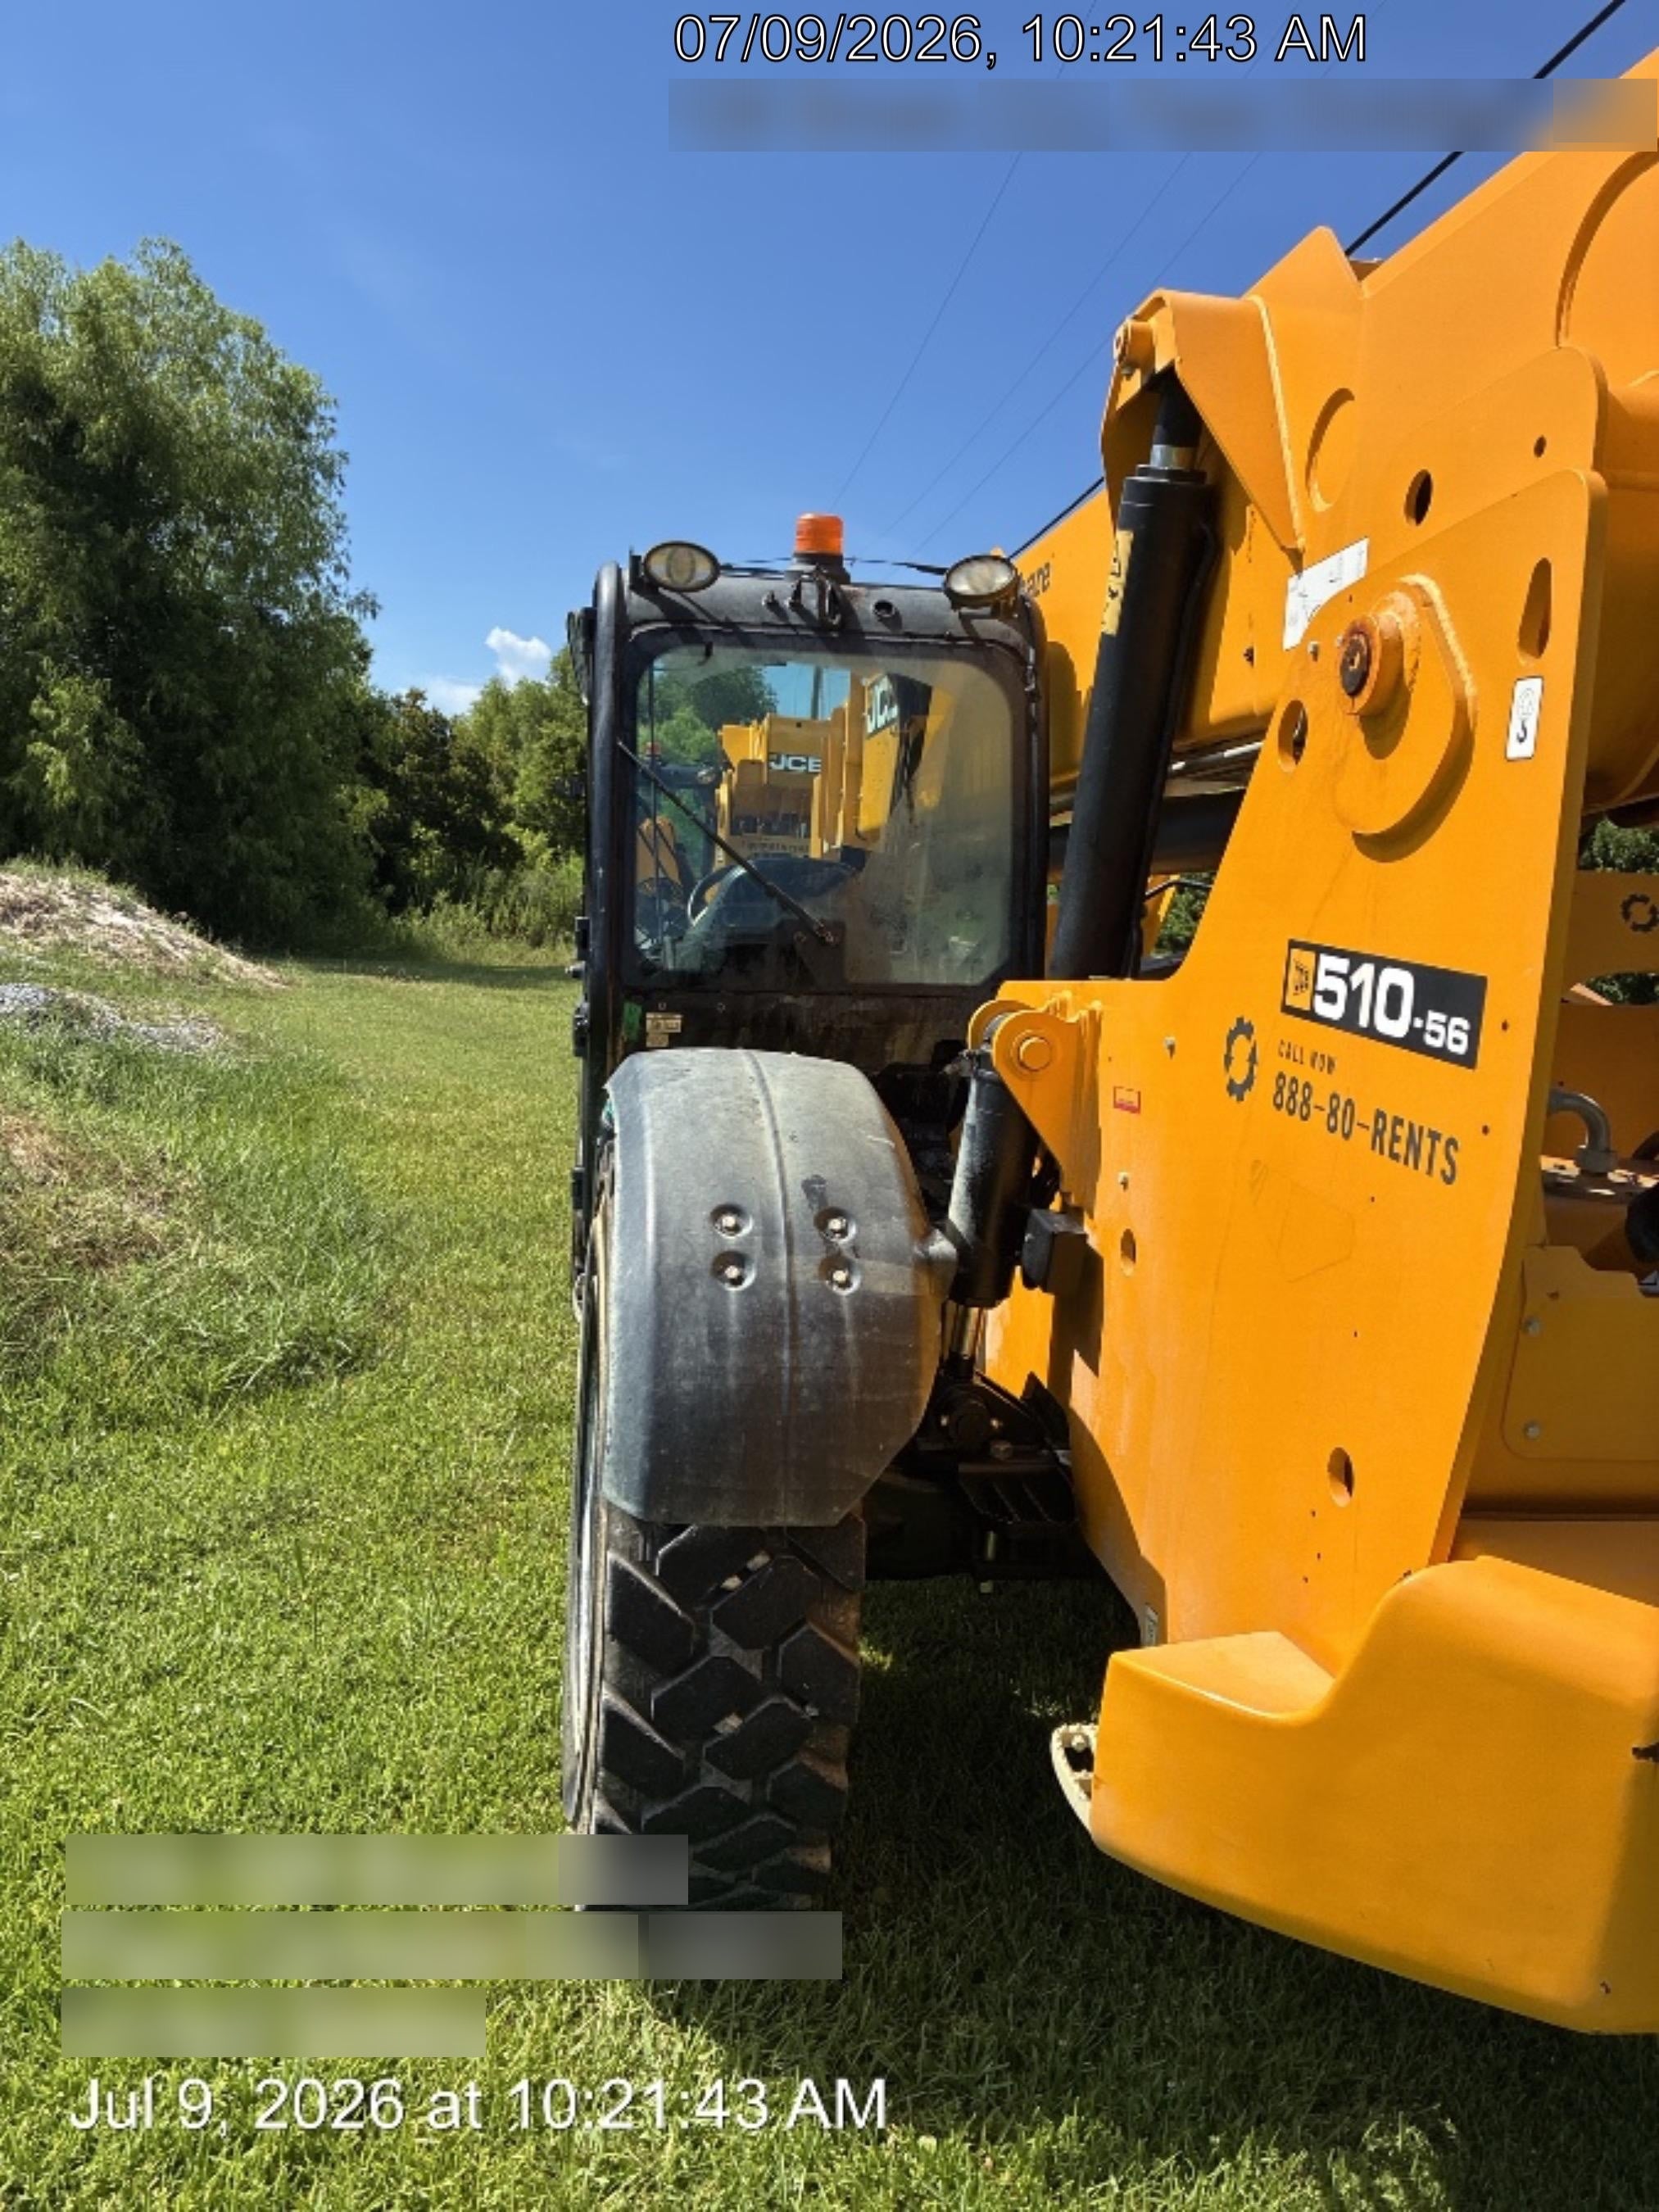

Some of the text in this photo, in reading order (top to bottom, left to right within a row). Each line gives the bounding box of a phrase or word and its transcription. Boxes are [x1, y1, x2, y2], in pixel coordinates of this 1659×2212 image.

[1278, 1039, 1336, 1075] CALL NOW
[1272, 1071, 1459, 1185] 888-80-RENTS
